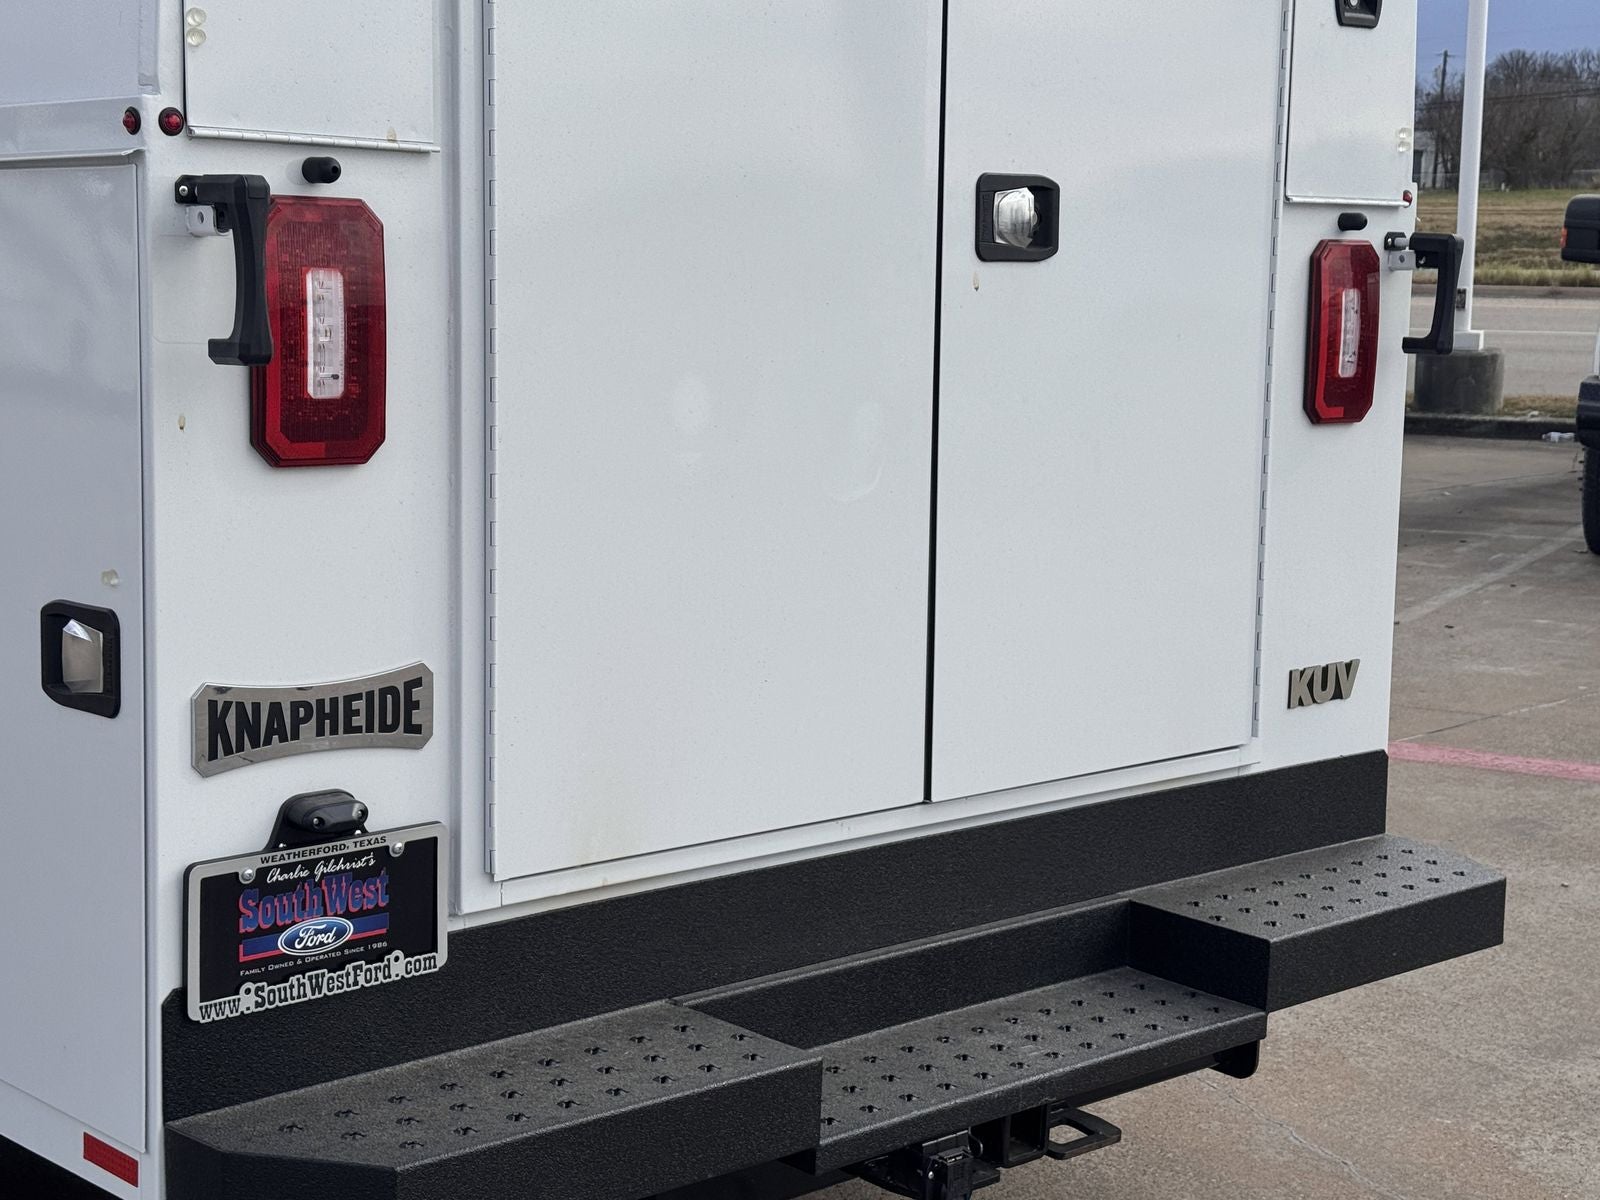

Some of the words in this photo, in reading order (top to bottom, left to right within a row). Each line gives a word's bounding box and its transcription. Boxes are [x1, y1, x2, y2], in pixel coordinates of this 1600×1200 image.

[1287, 659, 1360, 709] KUV
[208, 676, 423, 762] KNAPHEIDE
[260, 843, 350, 865] WEATHERFORD,
[353, 835, 387, 852] TEXAS
[267, 866, 310, 884] Charlie
[314, 852, 376, 882] Gilchrist's
[294, 923, 336, 949] Ford
[240, 966, 265, 977] FAMILY
[368, 941, 388, 950] 1986
